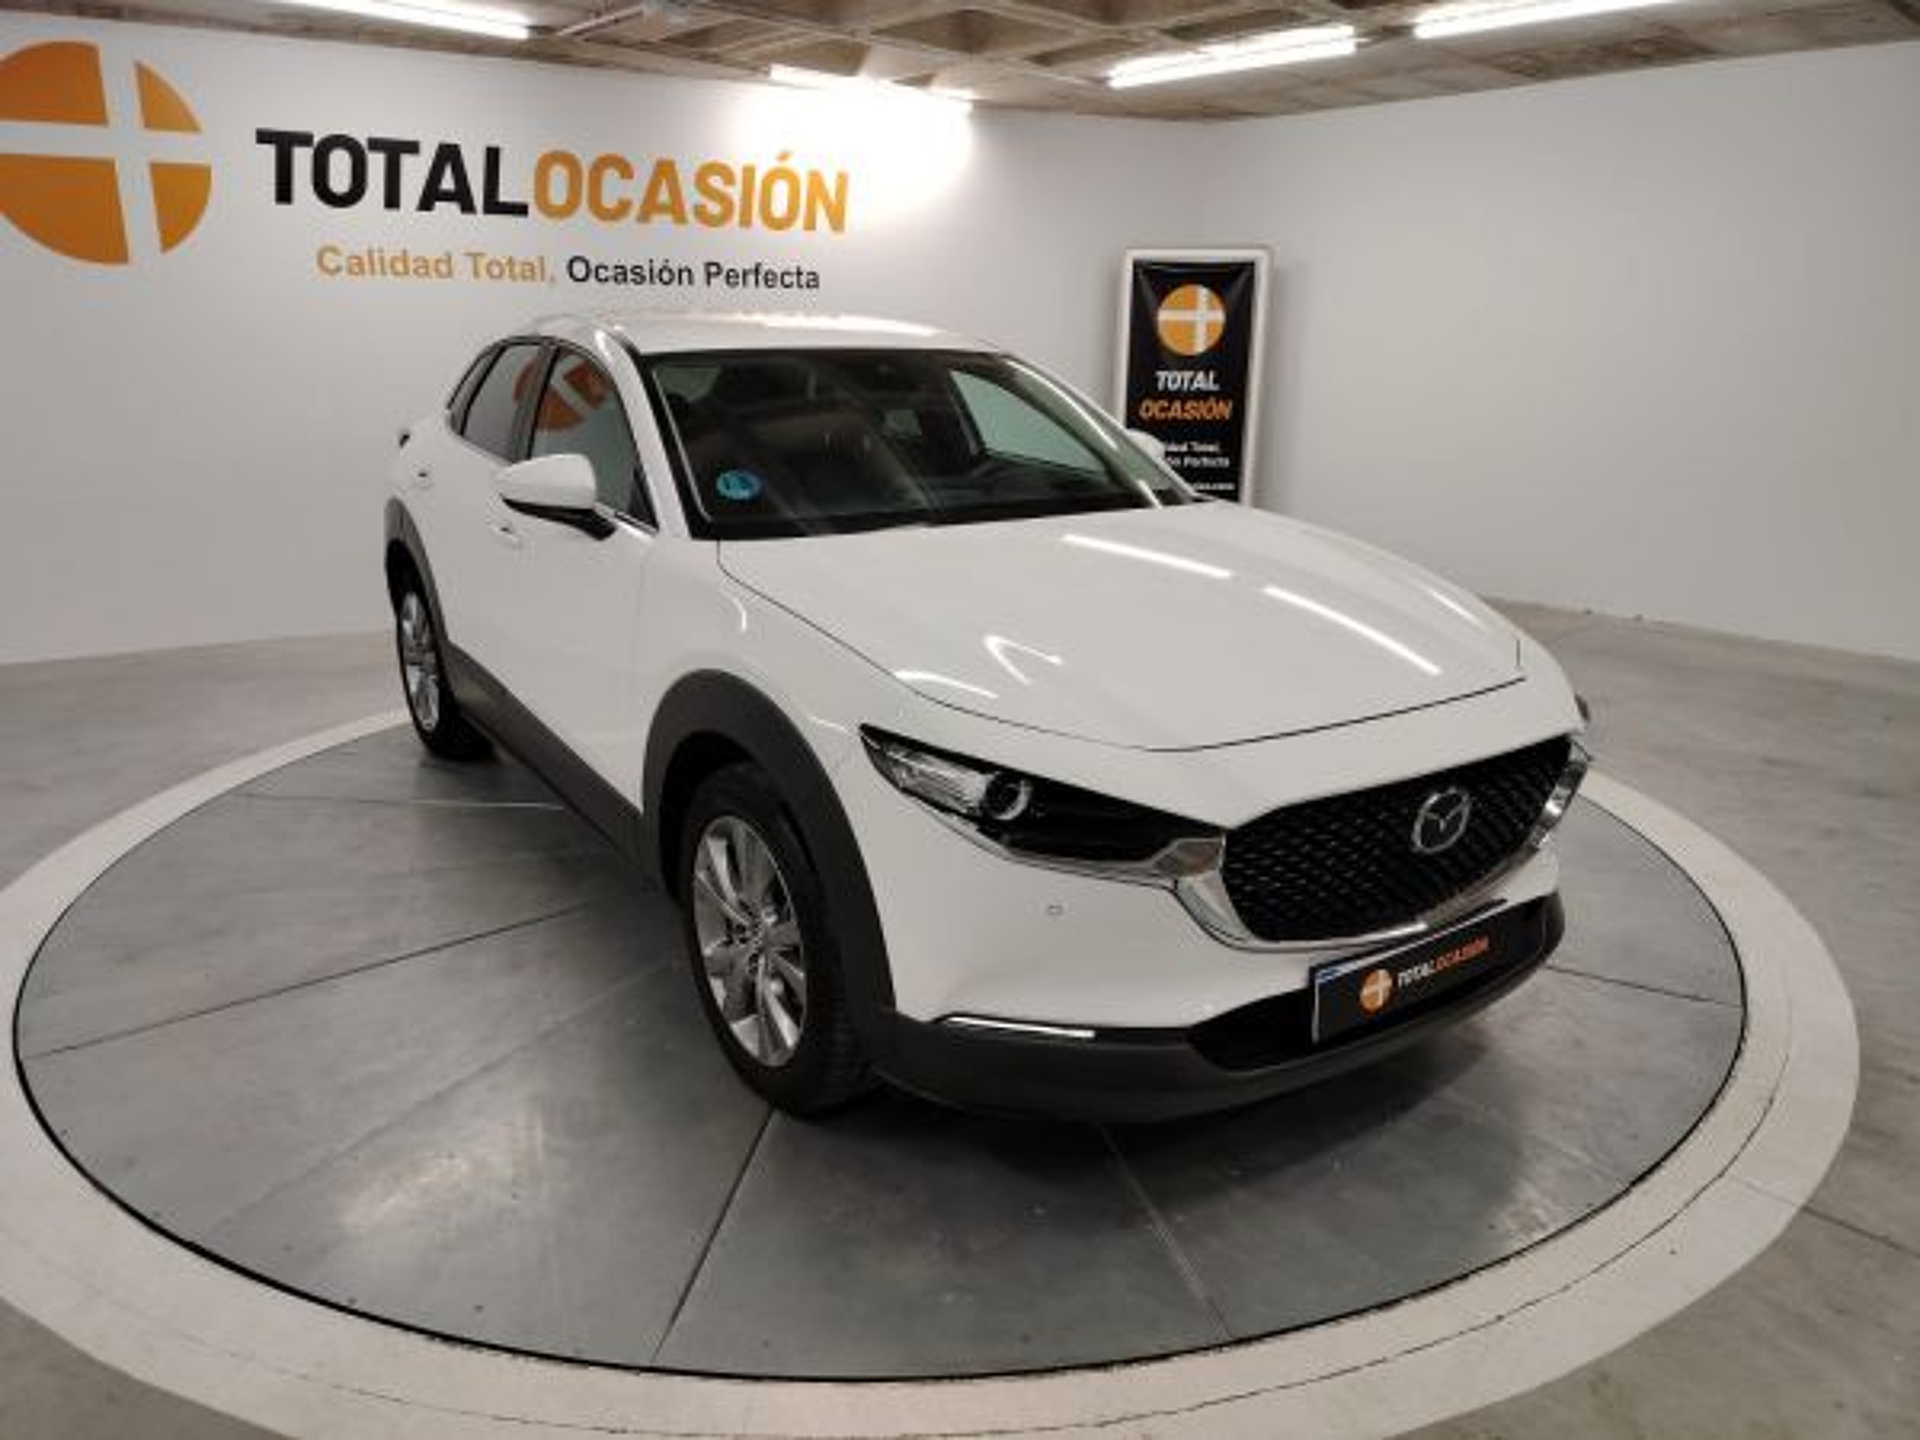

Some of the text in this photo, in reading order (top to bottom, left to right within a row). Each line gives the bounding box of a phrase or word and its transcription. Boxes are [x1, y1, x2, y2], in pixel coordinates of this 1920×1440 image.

[316, 246, 453, 278] Calidad
[566, 255, 695, 286] Ocasión
[704, 261, 820, 289] Perfecta
[1155, 370, 1220, 392] TOTAL
[1139, 397, 1233, 420] OCASIÓN
